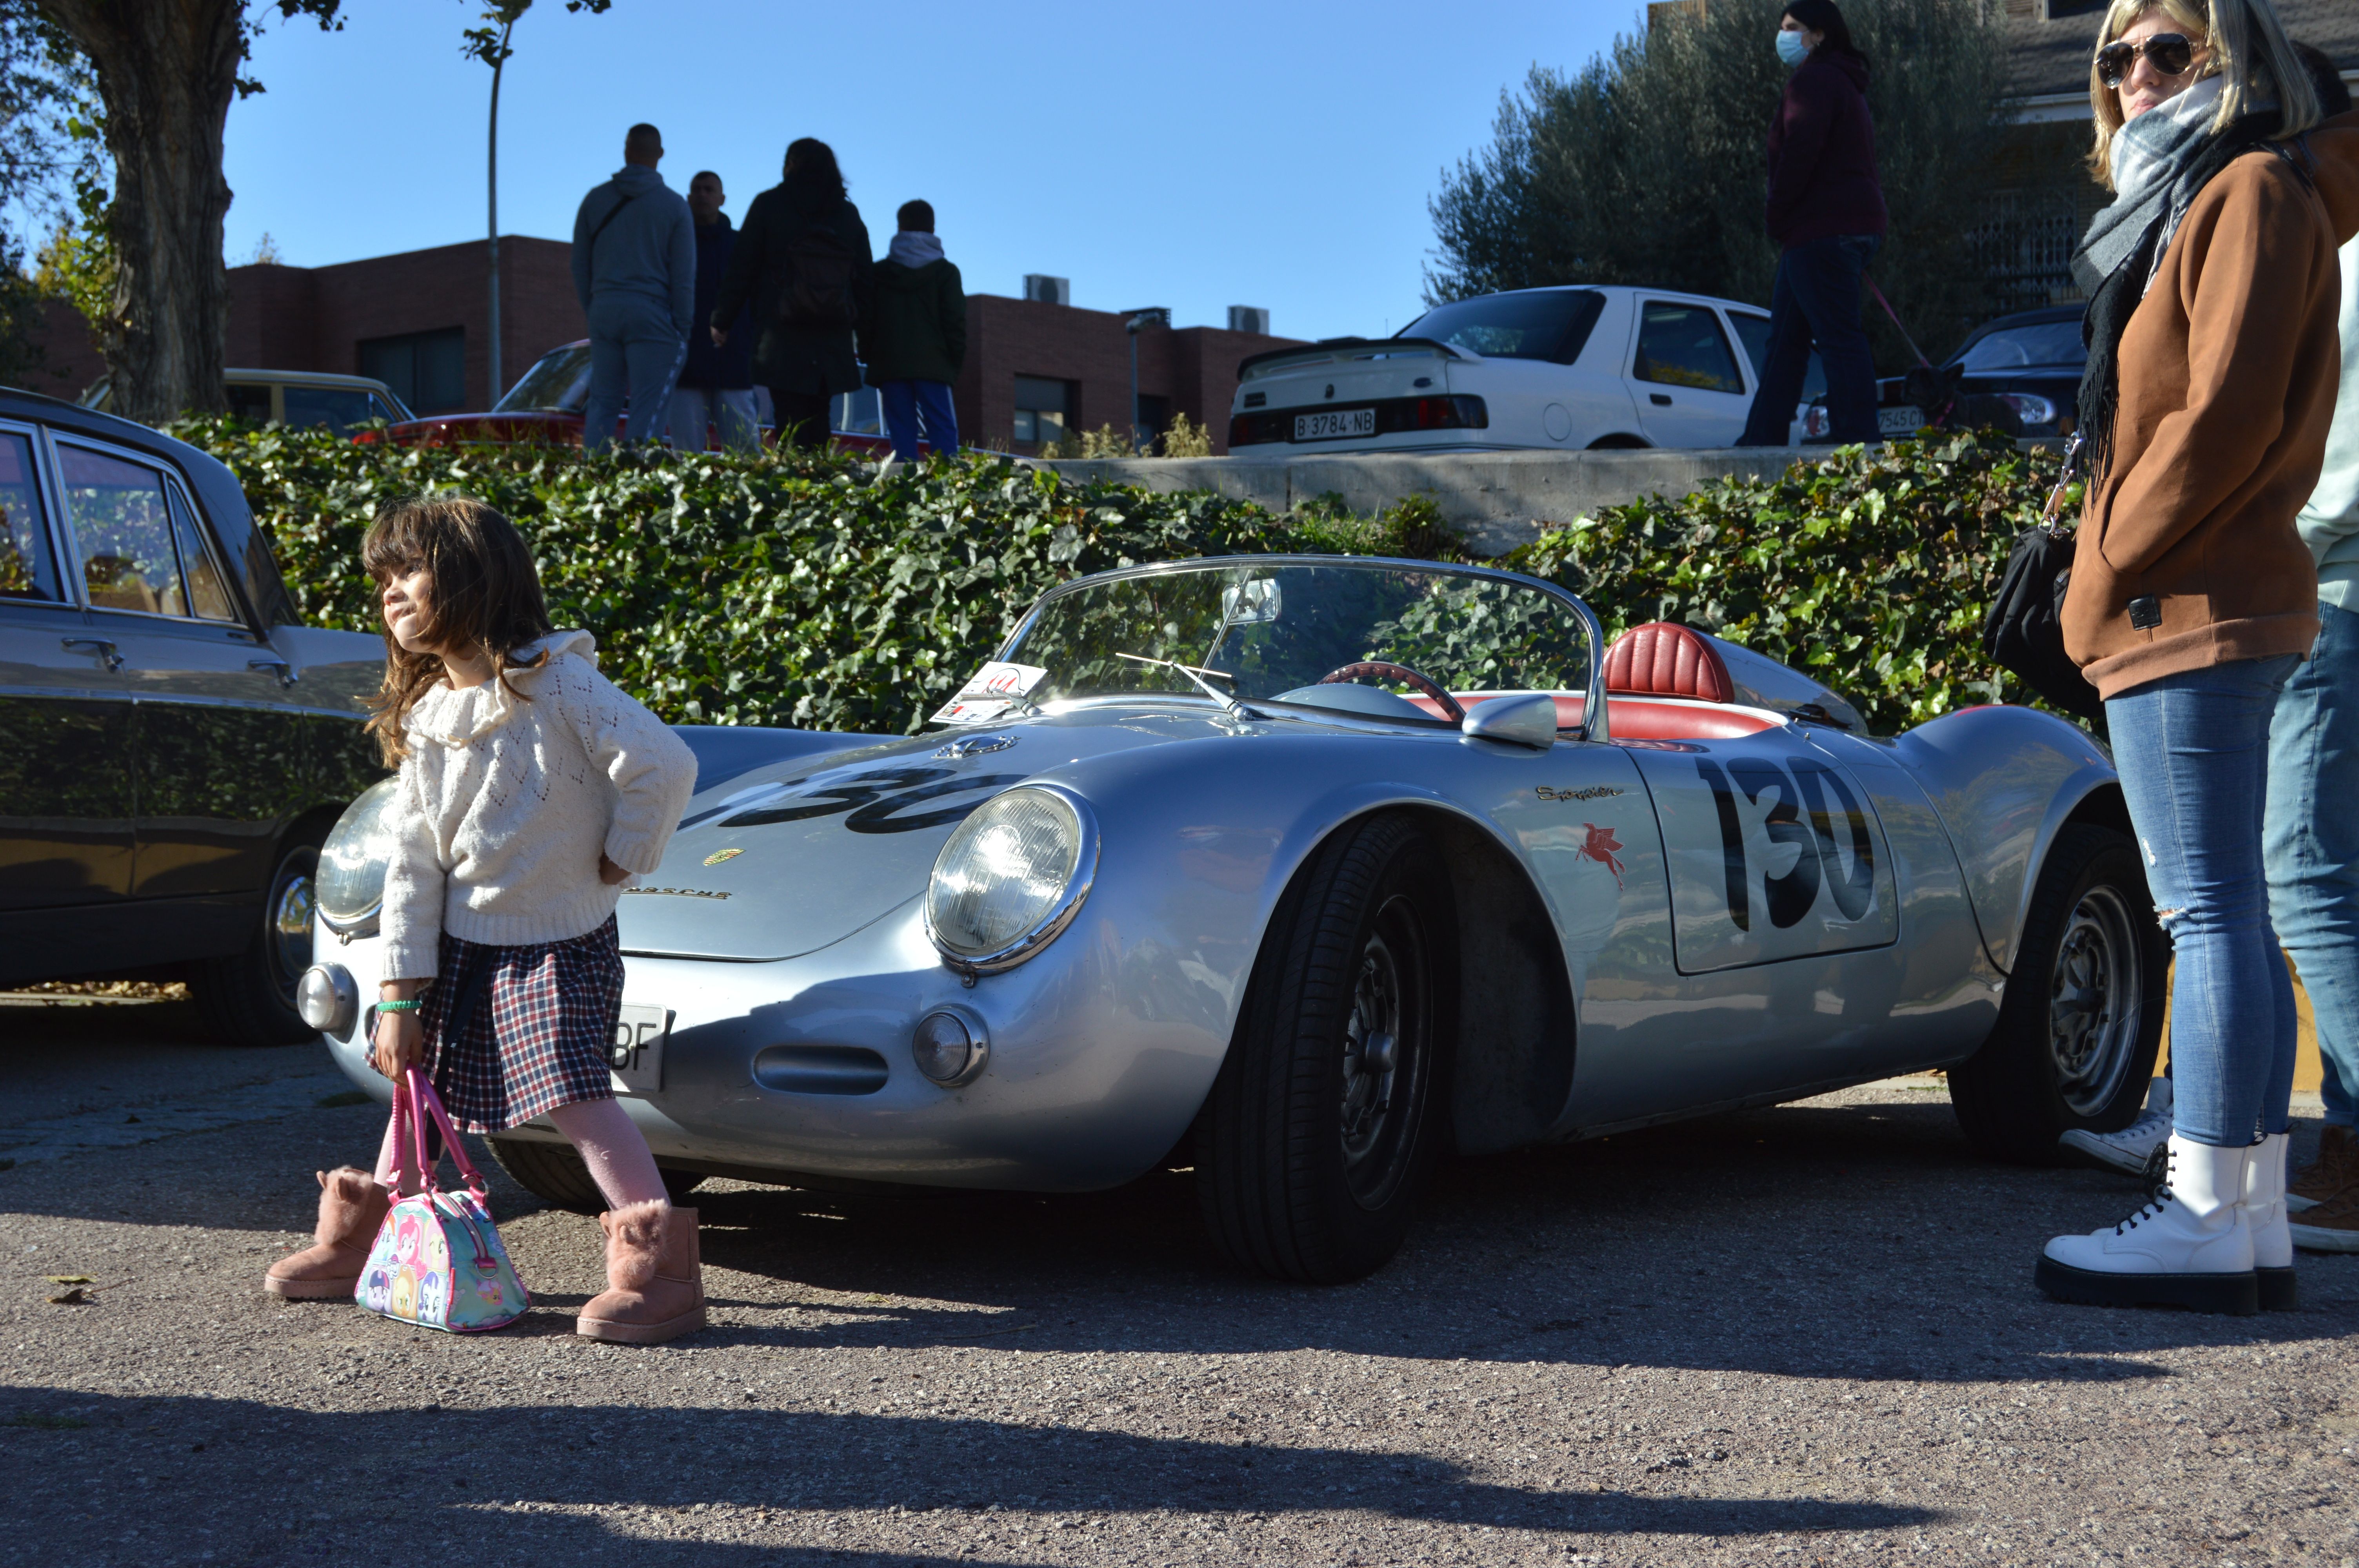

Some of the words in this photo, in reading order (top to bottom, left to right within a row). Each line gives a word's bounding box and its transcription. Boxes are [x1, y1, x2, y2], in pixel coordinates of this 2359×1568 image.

[1880, 411, 1907, 428] 7545
[677, 768, 1030, 834] 130
[1536, 786, 1624, 801] Spyder
[1694, 756, 1874, 932] 130
[623, 887, 732, 899] ORSCHE
